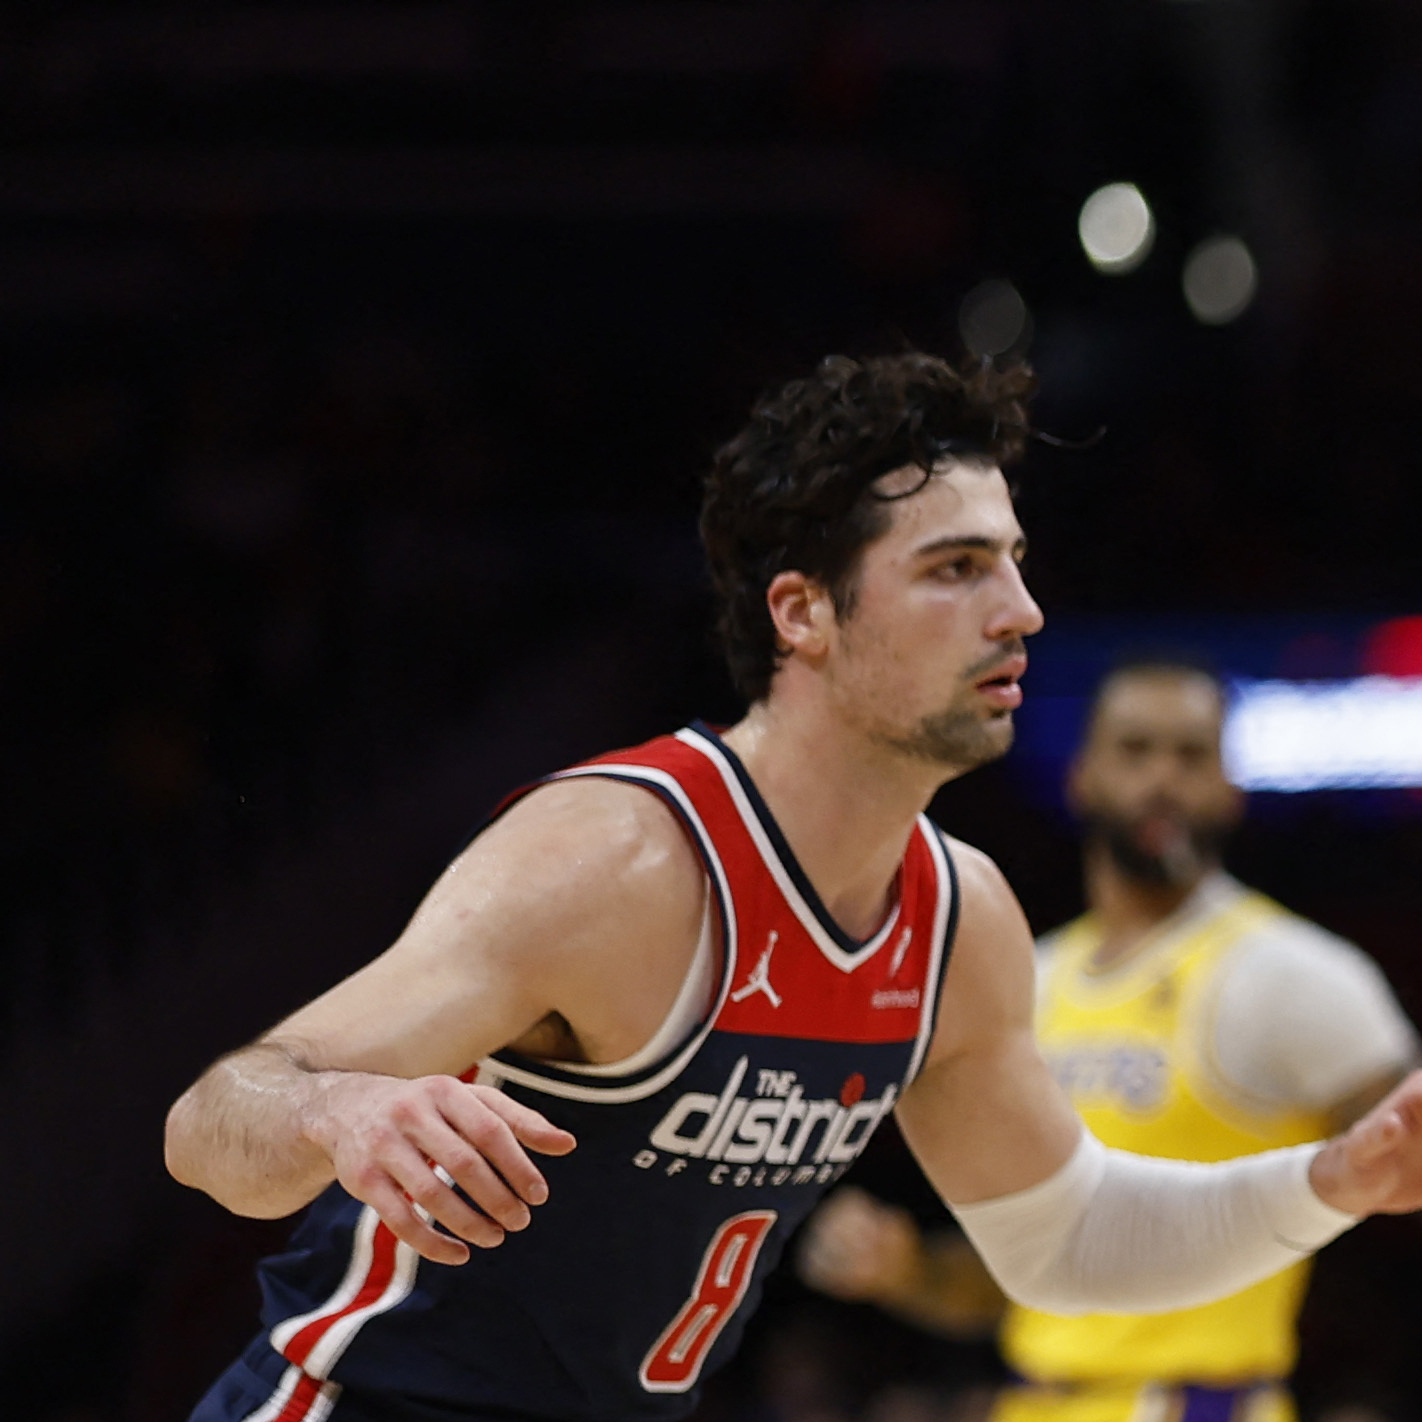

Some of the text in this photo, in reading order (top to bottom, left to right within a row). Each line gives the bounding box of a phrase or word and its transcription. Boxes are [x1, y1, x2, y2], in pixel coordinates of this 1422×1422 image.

[755, 1068, 798, 1098] THE
[631, 1149, 689, 1177] OF
[638, 1209, 779, 1394] 8
